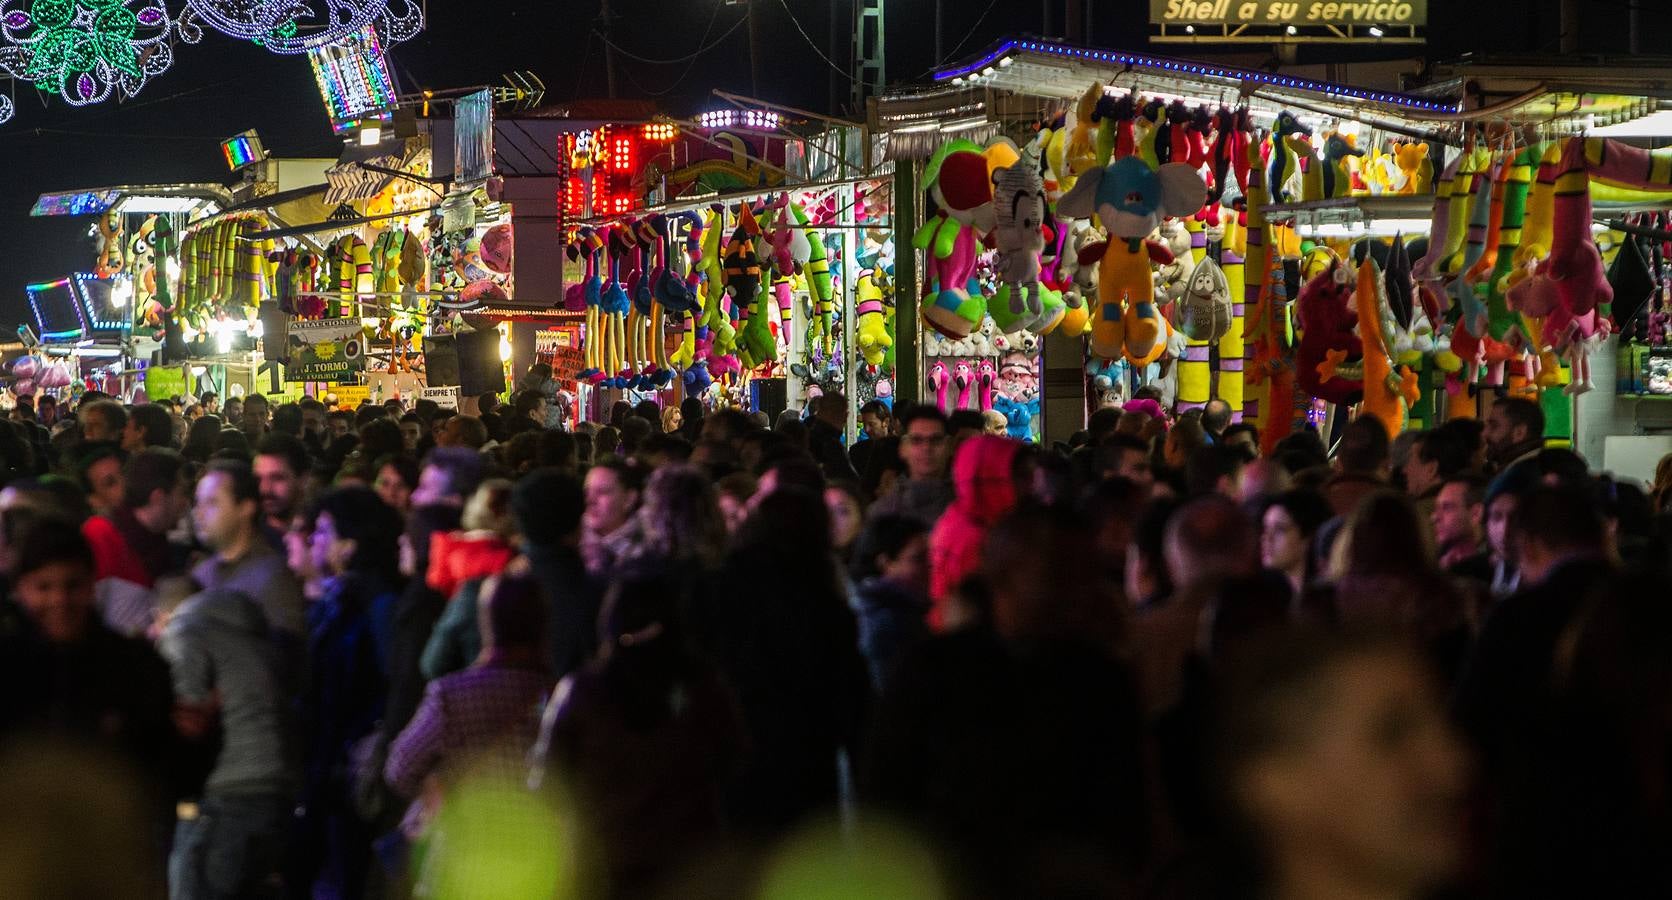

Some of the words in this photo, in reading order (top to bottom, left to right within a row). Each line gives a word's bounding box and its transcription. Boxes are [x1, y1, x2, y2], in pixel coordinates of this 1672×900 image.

[1163, 0, 1229, 20] Shell
[1238, 2, 1256, 20] a
[1266, 2, 1297, 20] su
[1306, 0, 1413, 20] servicio
[314, 361, 348, 373] TORMO
[424, 389, 449, 397] SIEMPRE
